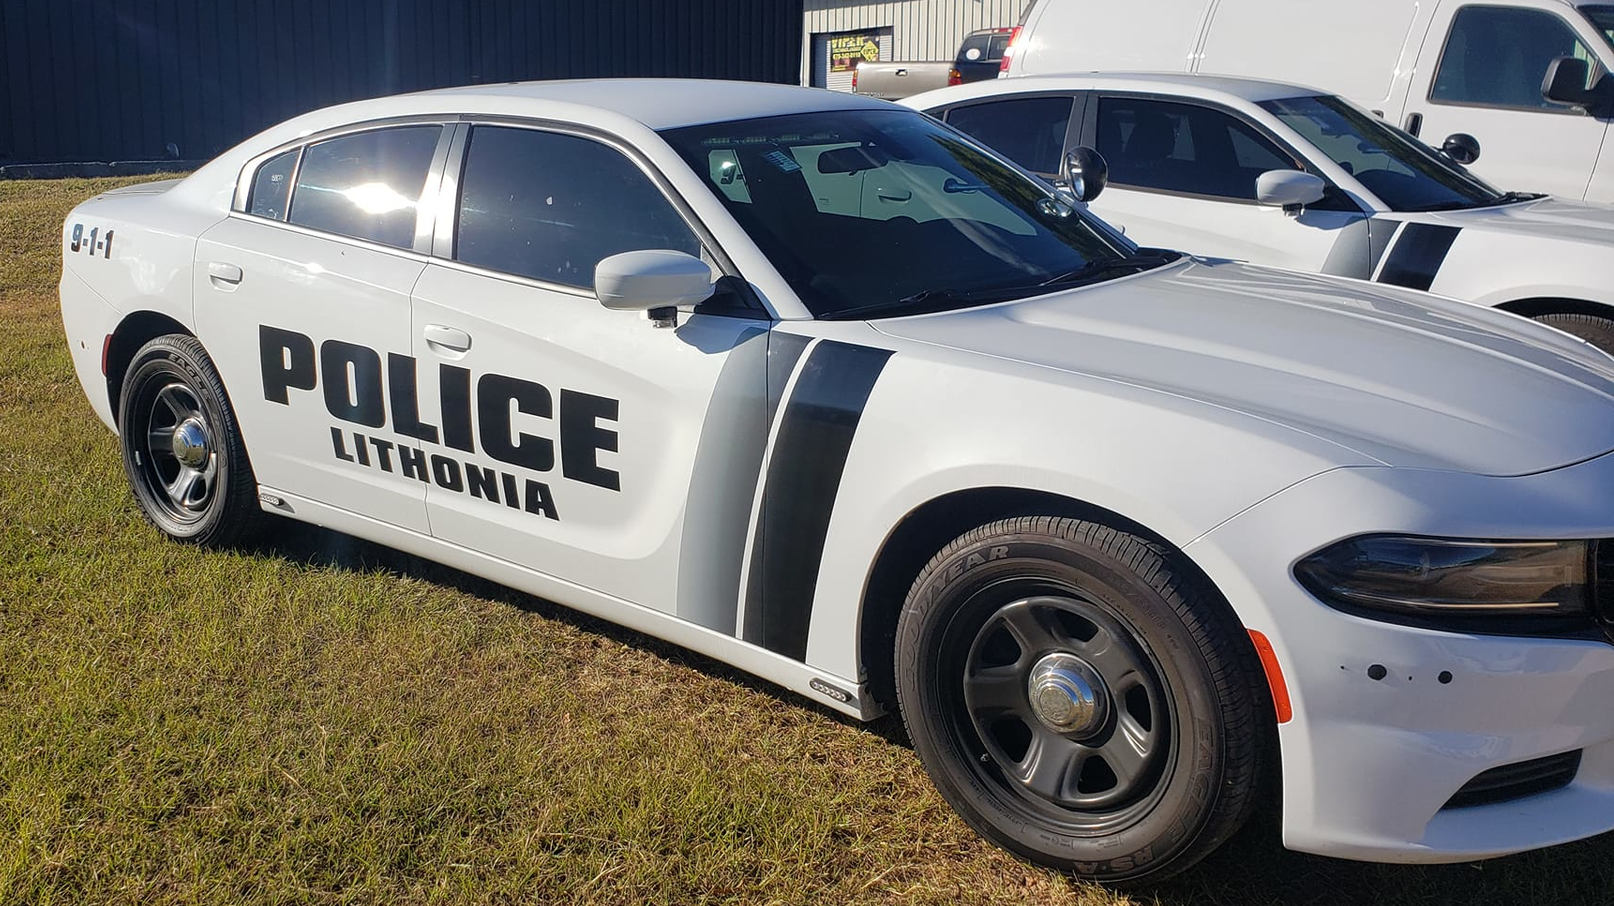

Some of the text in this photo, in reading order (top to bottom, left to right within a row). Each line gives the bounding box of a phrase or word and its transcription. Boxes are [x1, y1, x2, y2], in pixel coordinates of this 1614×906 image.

[71, 223, 114, 260] 9-1-1
[259, 324, 621, 492] POLICE
[330, 427, 560, 521] LITHONIA
